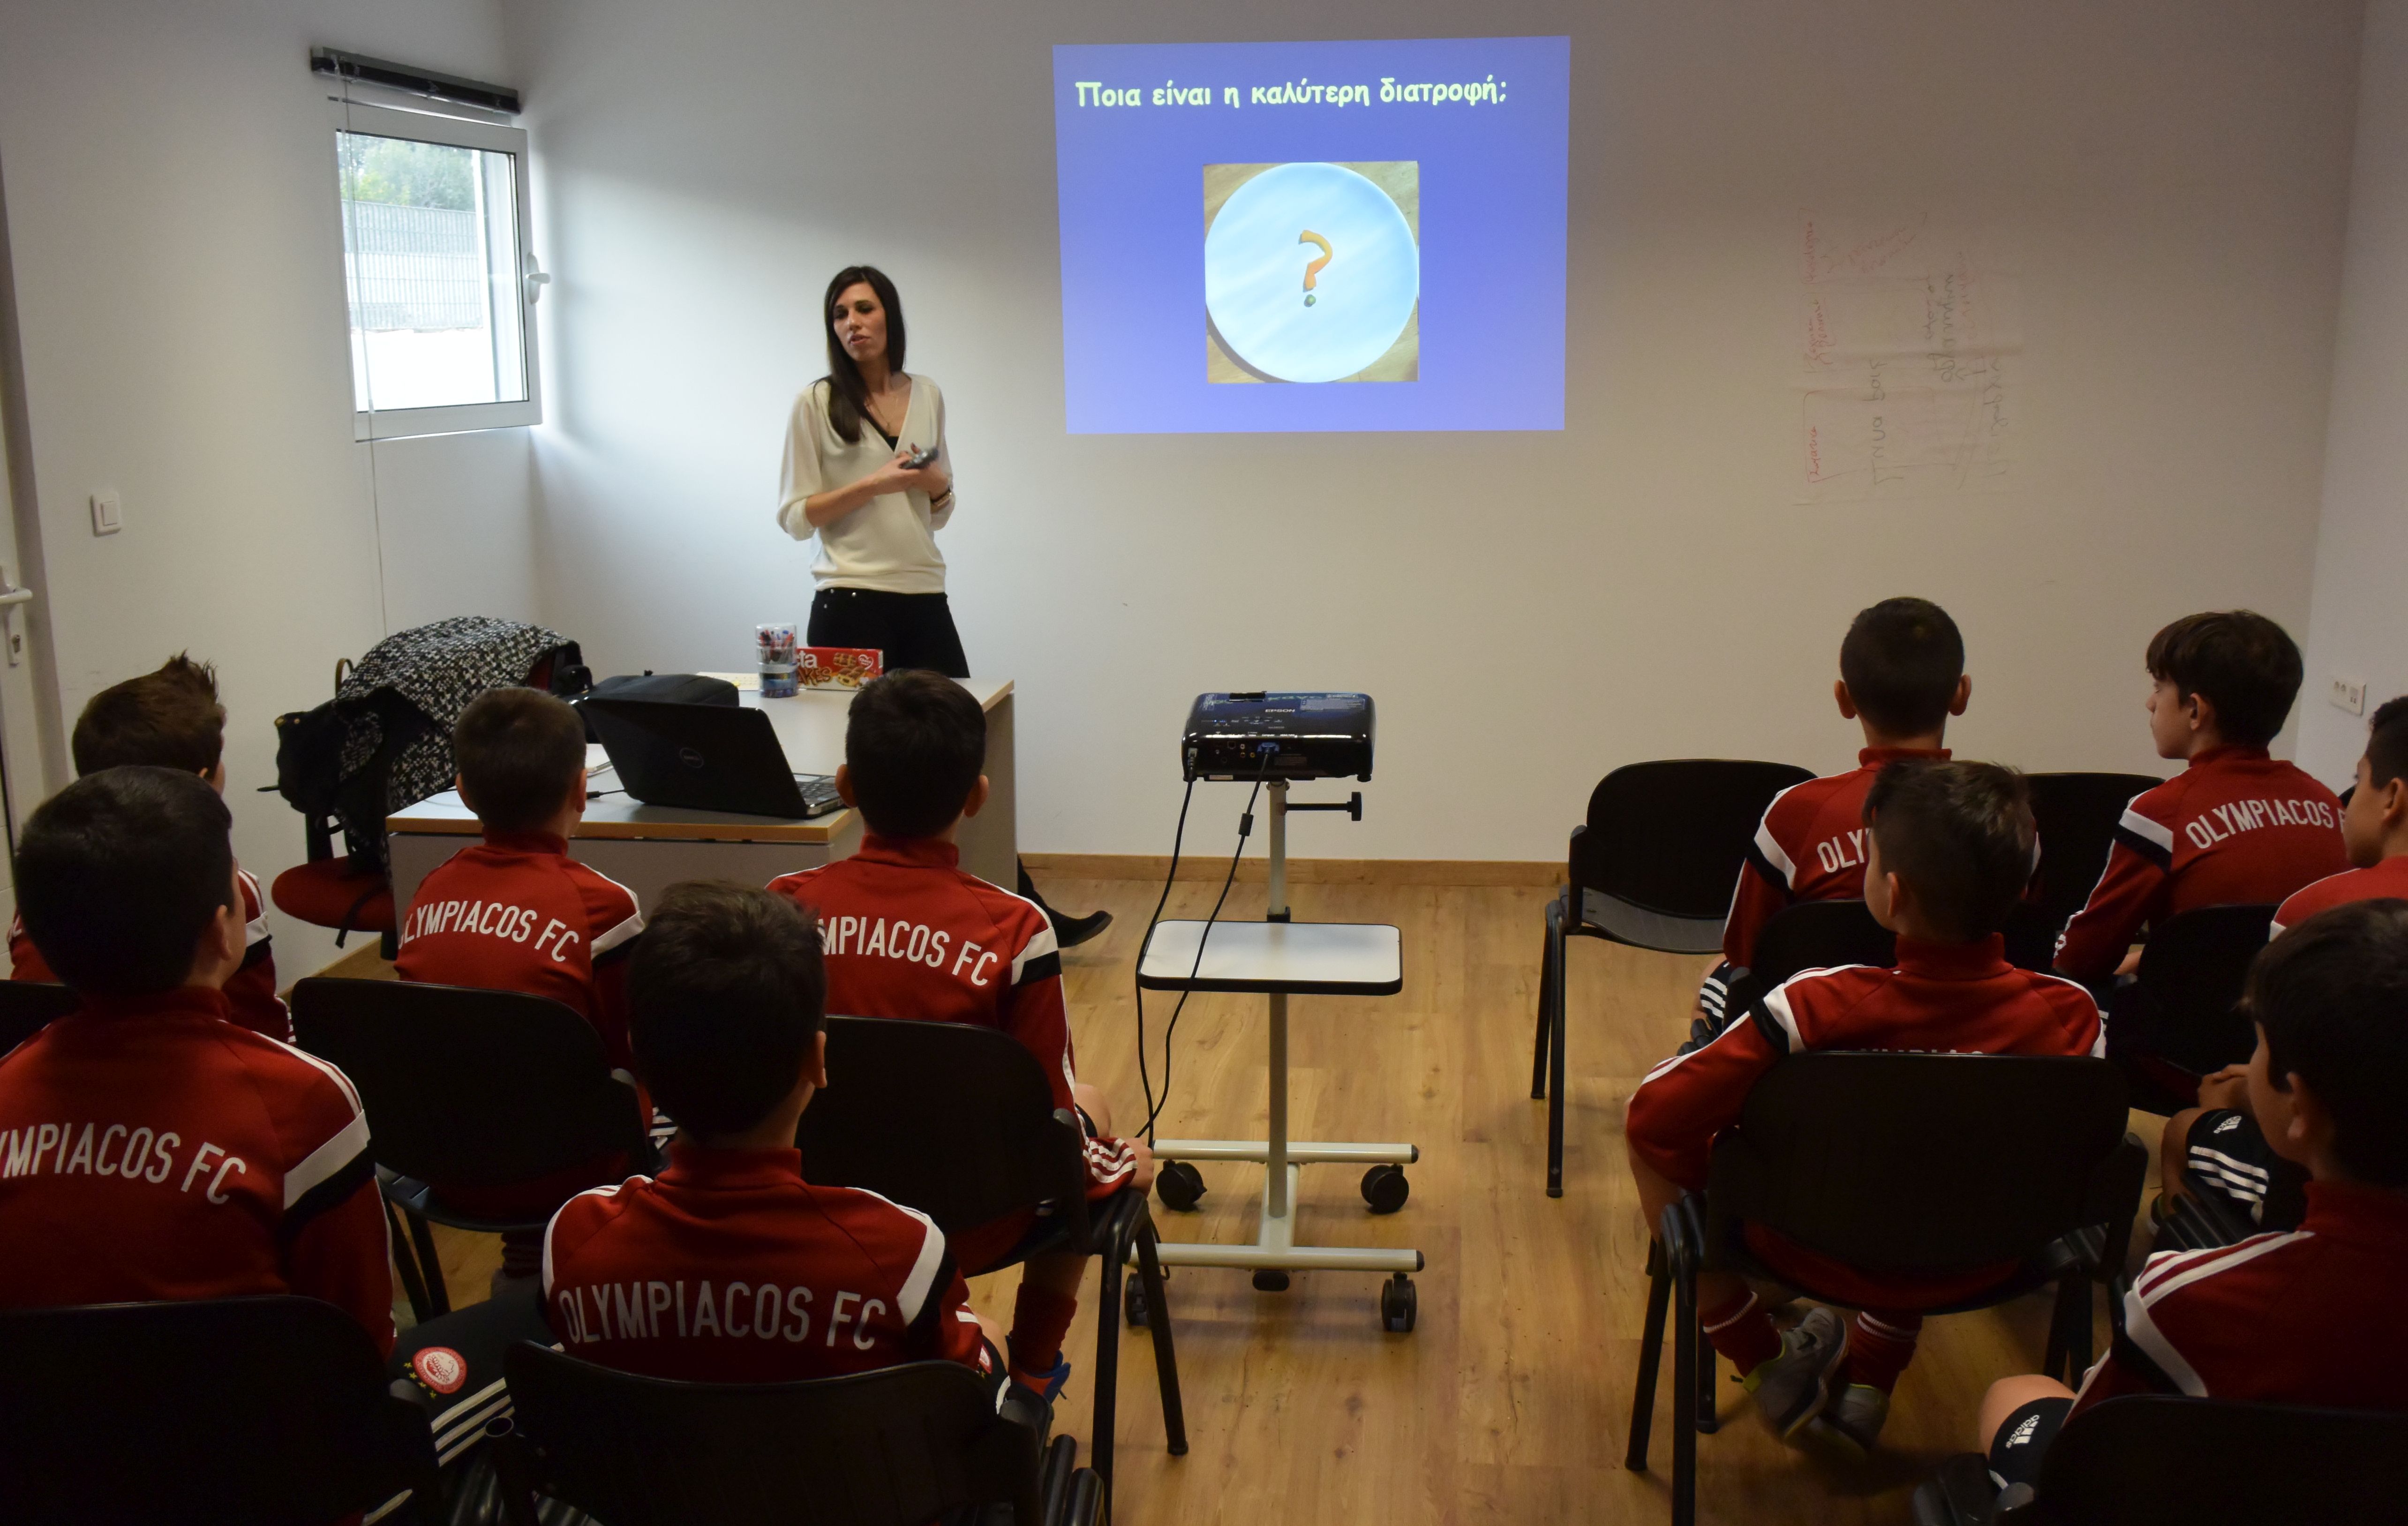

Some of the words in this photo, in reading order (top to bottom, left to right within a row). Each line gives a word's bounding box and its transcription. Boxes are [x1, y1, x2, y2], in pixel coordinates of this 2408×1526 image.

[1075, 81, 1141, 107] Ποια
[1153, 80, 1211, 106] είναι
[1224, 86, 1239, 108] η
[1251, 78, 1370, 107] καλύτερη
[1380, 75, 1506, 106] διατροφή;
[2186, 799, 2333, 849] OLYMPIACOS
[1817, 828, 1870, 872] OLY
[534, 918, 579, 962] FC
[952, 941, 997, 985] FC
[181, 1142, 246, 1204] FC
[558, 1280, 813, 1344] OLYMPIACOS
[826, 1290, 886, 1350] FC
[2006, 1414, 2040, 1449] adidas
